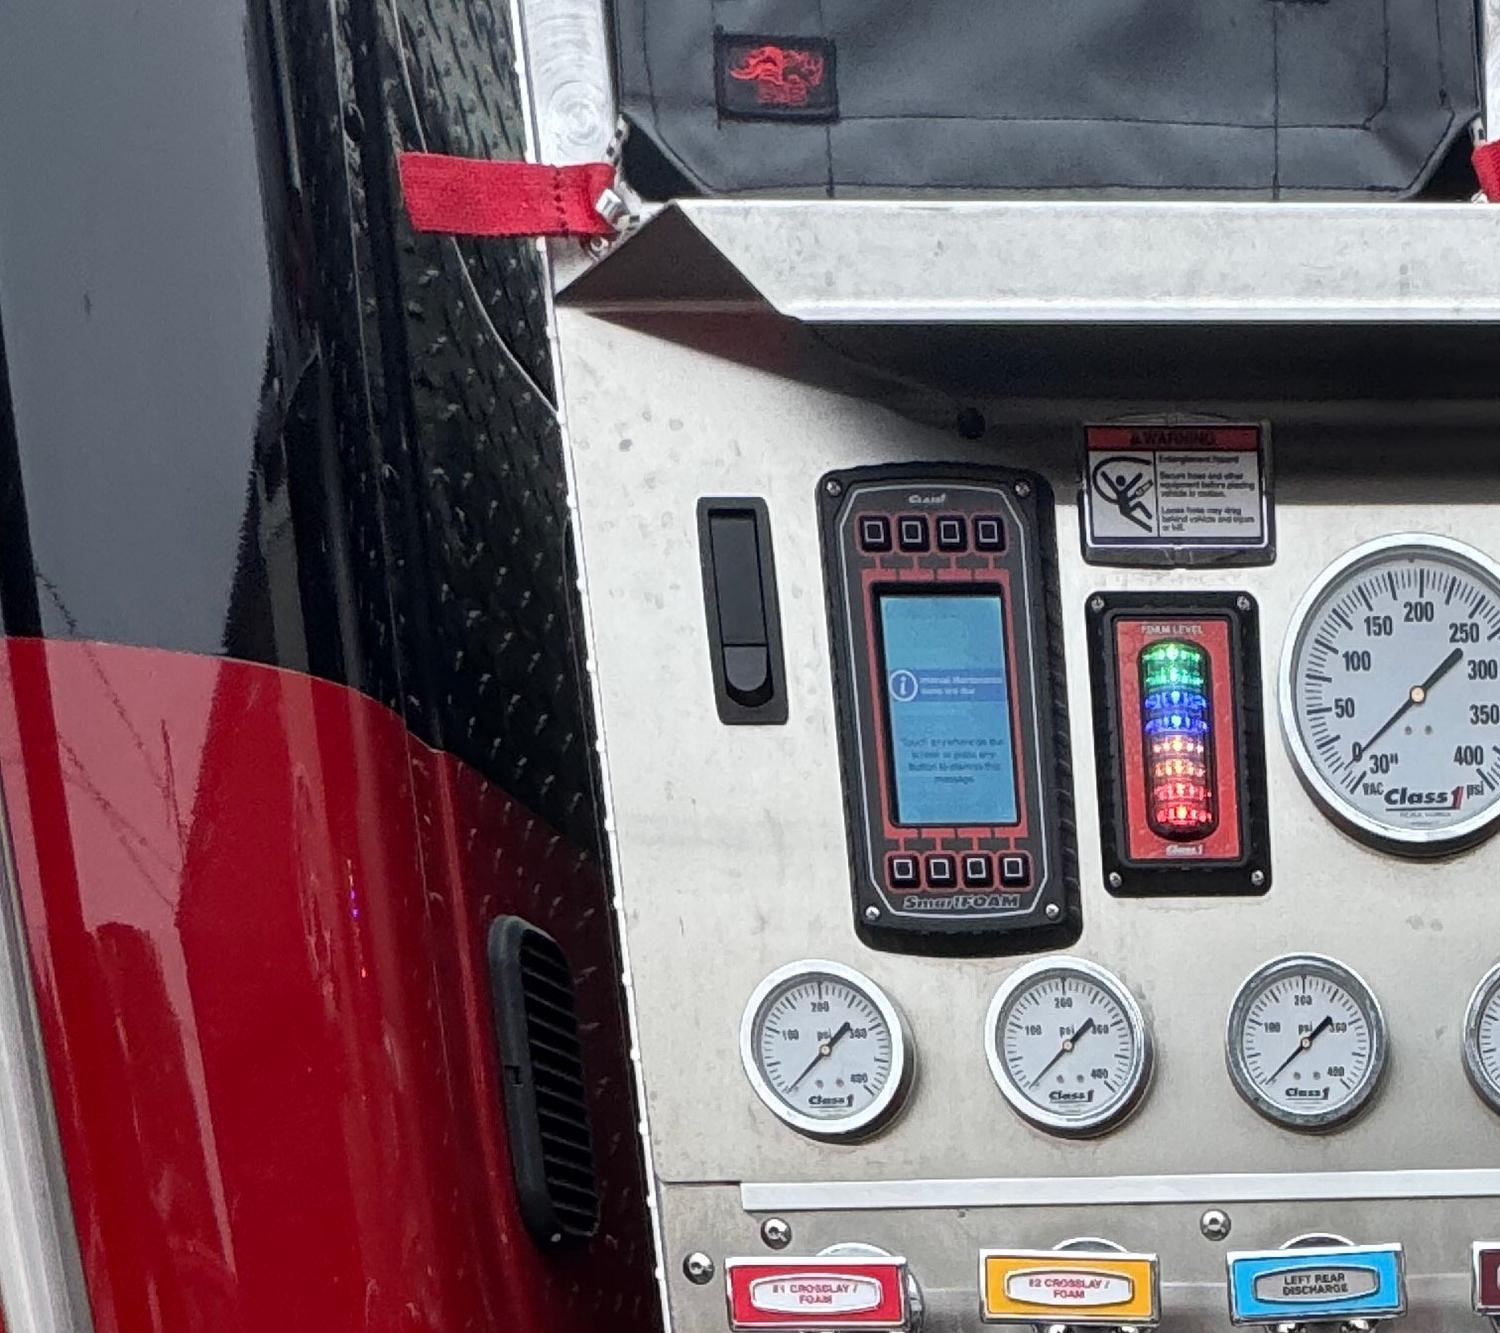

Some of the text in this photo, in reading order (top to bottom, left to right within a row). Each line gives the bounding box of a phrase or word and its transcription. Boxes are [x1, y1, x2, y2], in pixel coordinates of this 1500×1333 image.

[1404, 602, 1434, 622] 200
[1173, 625, 1204, 634] LEVEL
[1364, 616, 1393, 636] 150
[1449, 623, 1480, 643] 250
[1342, 651, 1371, 671] 100
[1468, 660, 1498, 680] 300
[1334, 698, 1355, 718] 50
[1470, 704, 1499, 725] 350
[1352, 742, 1363, 762] 0
[1454, 746, 1484, 765] 400
[1466, 781, 1485, 799] psi
[903, 894, 1020, 910] SmartFOAM
[1045, 1278, 1102, 1288] CROSSLAY
[1284, 1272, 1345, 1286] LEFT REAR
[790, 1285, 850, 1294] CROSSLAY
[1053, 1289, 1085, 1299] FOAM
[1283, 1283, 1348, 1296] DISCHARGE
[800, 1295, 833, 1305] FOAM
